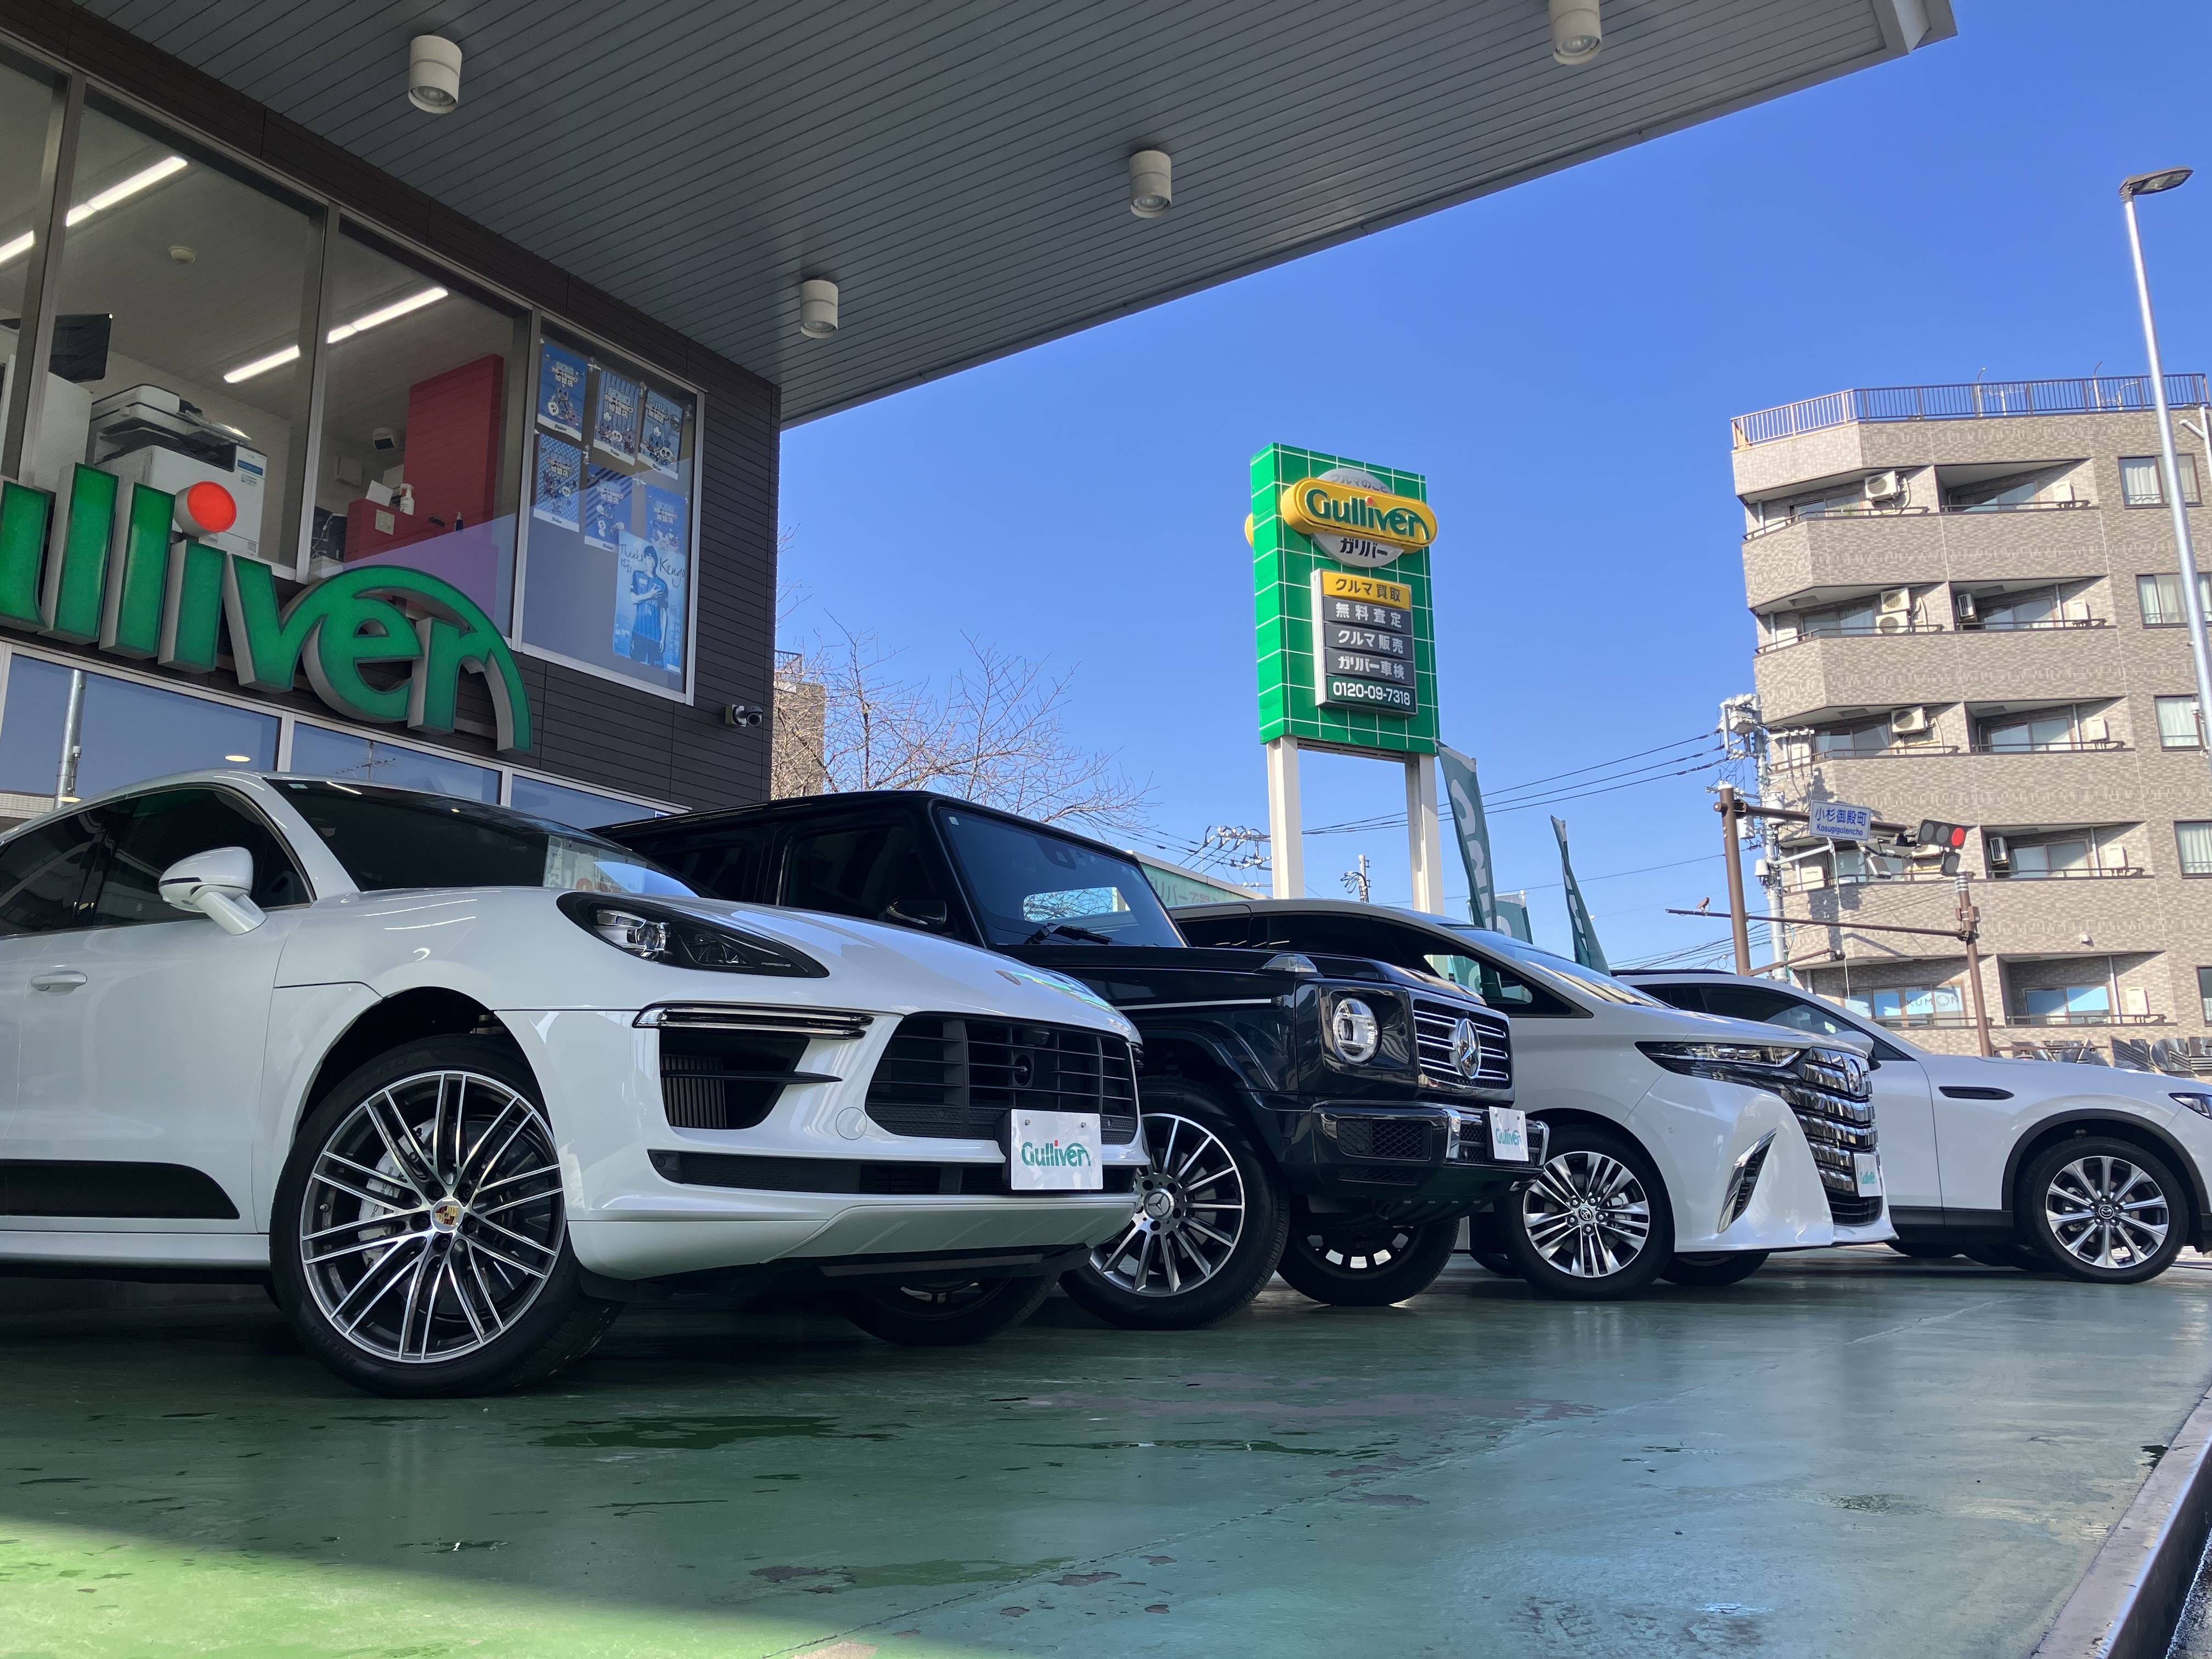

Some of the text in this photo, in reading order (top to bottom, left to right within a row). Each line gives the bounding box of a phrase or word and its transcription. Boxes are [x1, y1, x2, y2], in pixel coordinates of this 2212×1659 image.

[1305, 488, 1430, 540] Gulliver
[1340, 538, 1388, 559] ガリバー
[1335, 602, 1402, 628] 無料査定
[1338, 656, 1404, 680] ガリバー車検
[1333, 681, 1410, 706] 0120-09-7318
[1815, 807, 1867, 826] 小杉御殿町
[1816, 823, 1863, 836] Kosugigotencho
[1906, 994, 1959, 1008] KUMON
[1496, 1127, 1522, 1146] Gulliver
[1021, 1139, 1091, 1167] Gulliver
